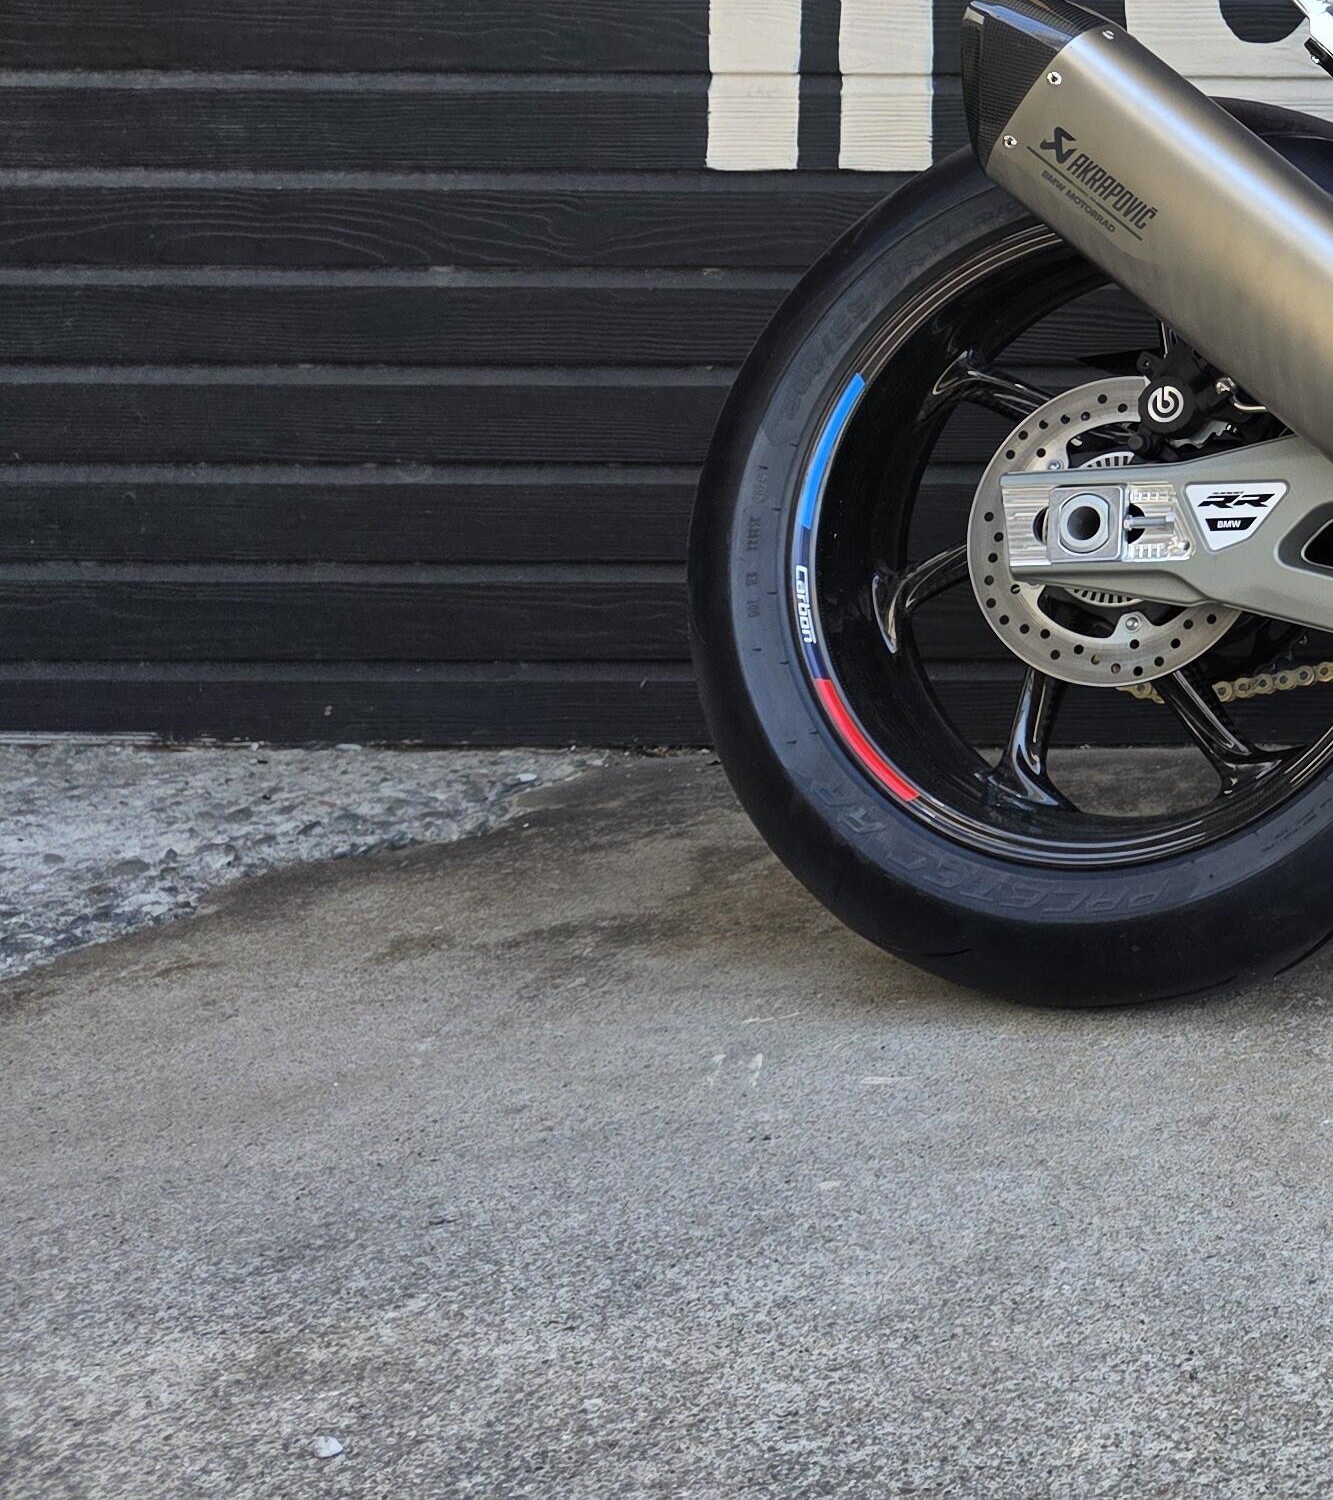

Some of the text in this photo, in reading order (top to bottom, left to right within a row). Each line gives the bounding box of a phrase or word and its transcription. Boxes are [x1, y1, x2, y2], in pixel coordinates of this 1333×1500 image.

[1040, 170, 1116, 233] BMW MOTORRAD
[1197, 493, 1275, 508] RR
[1217, 520, 1241, 528] BMW
[796, 565, 817, 644] Carbon
